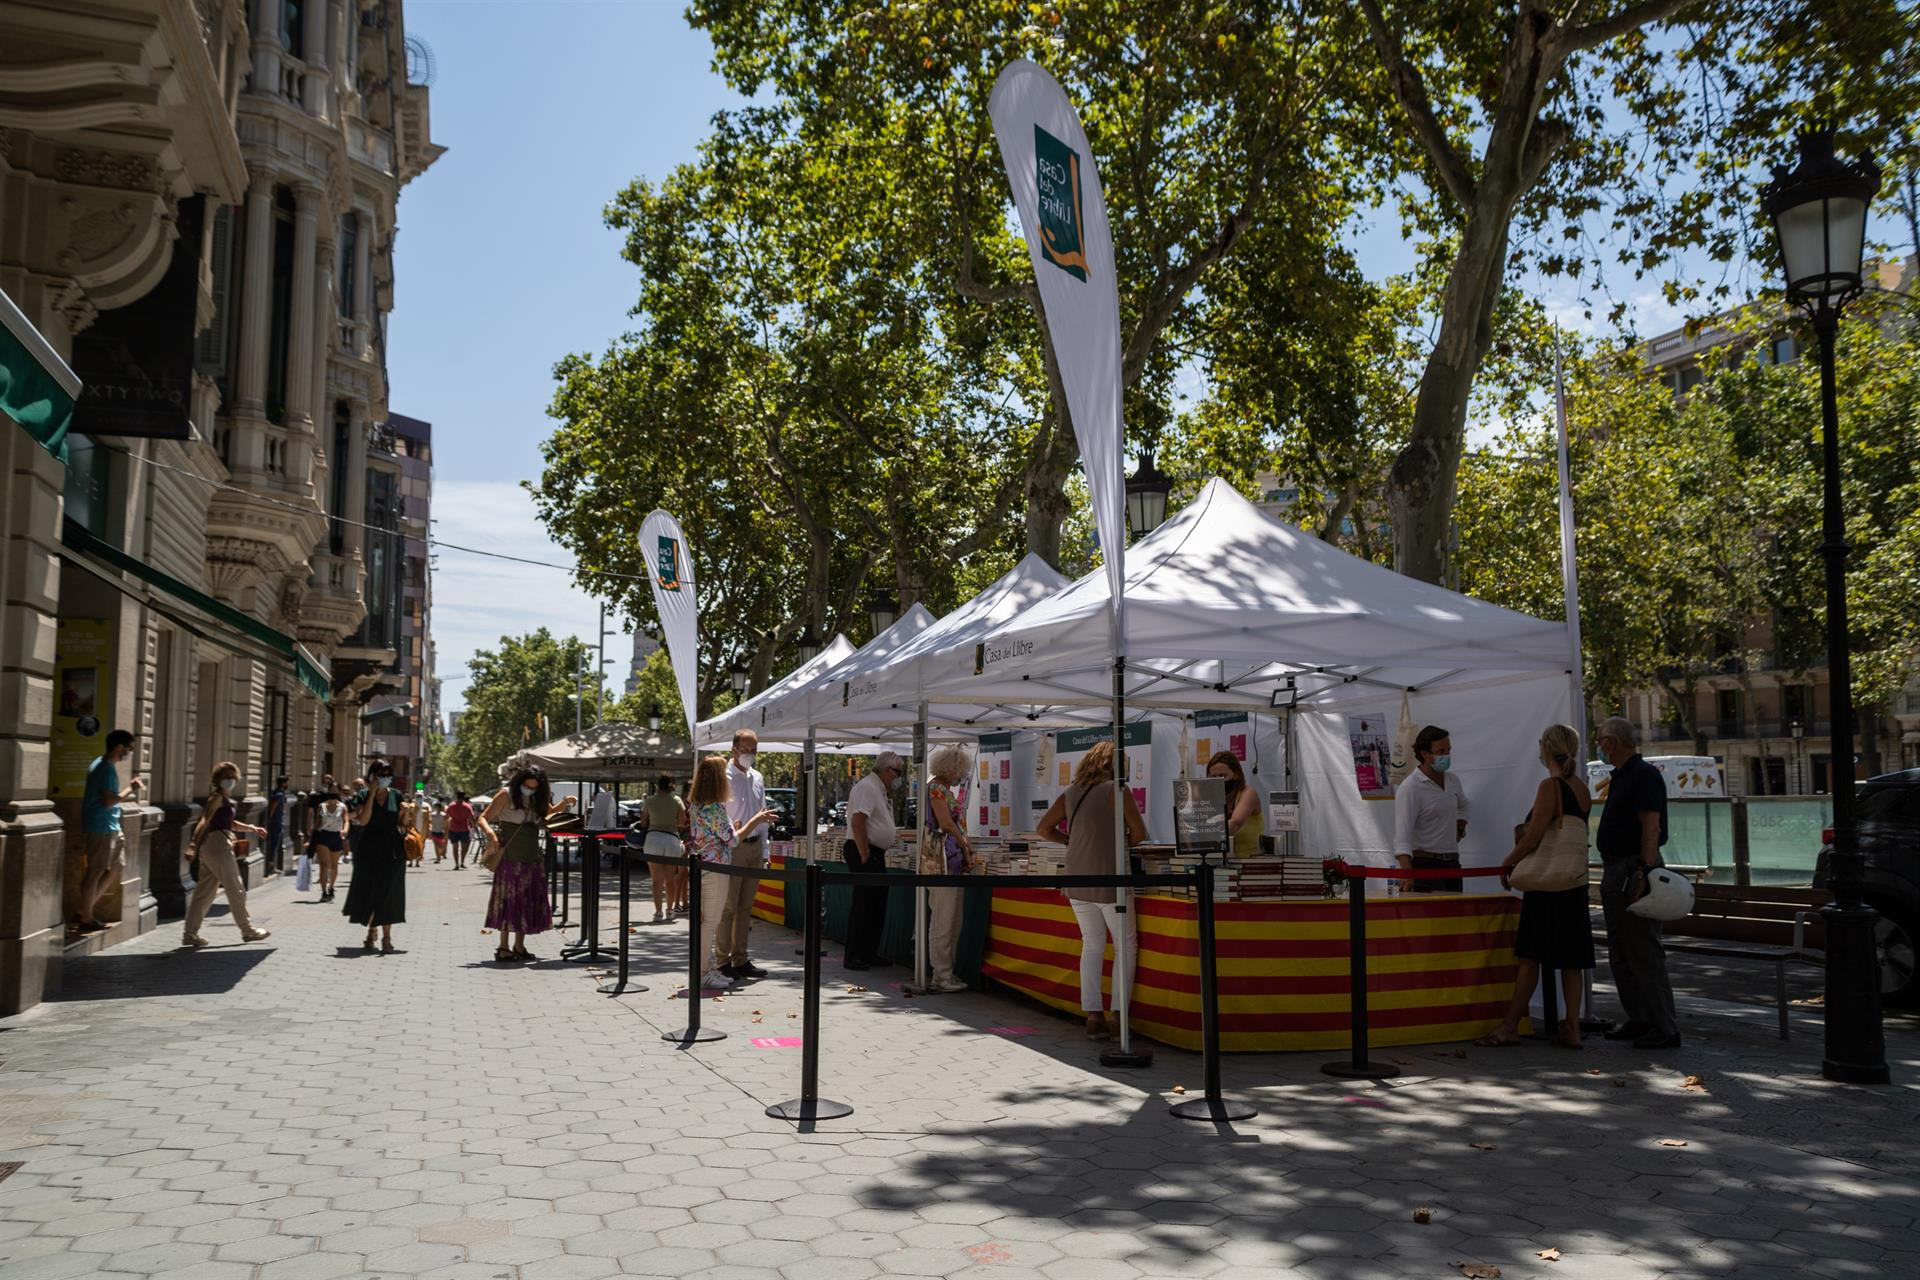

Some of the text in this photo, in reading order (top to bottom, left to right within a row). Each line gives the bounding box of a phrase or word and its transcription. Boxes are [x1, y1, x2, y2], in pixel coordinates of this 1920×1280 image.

[985, 640, 1034, 664] Casa del Llibre
